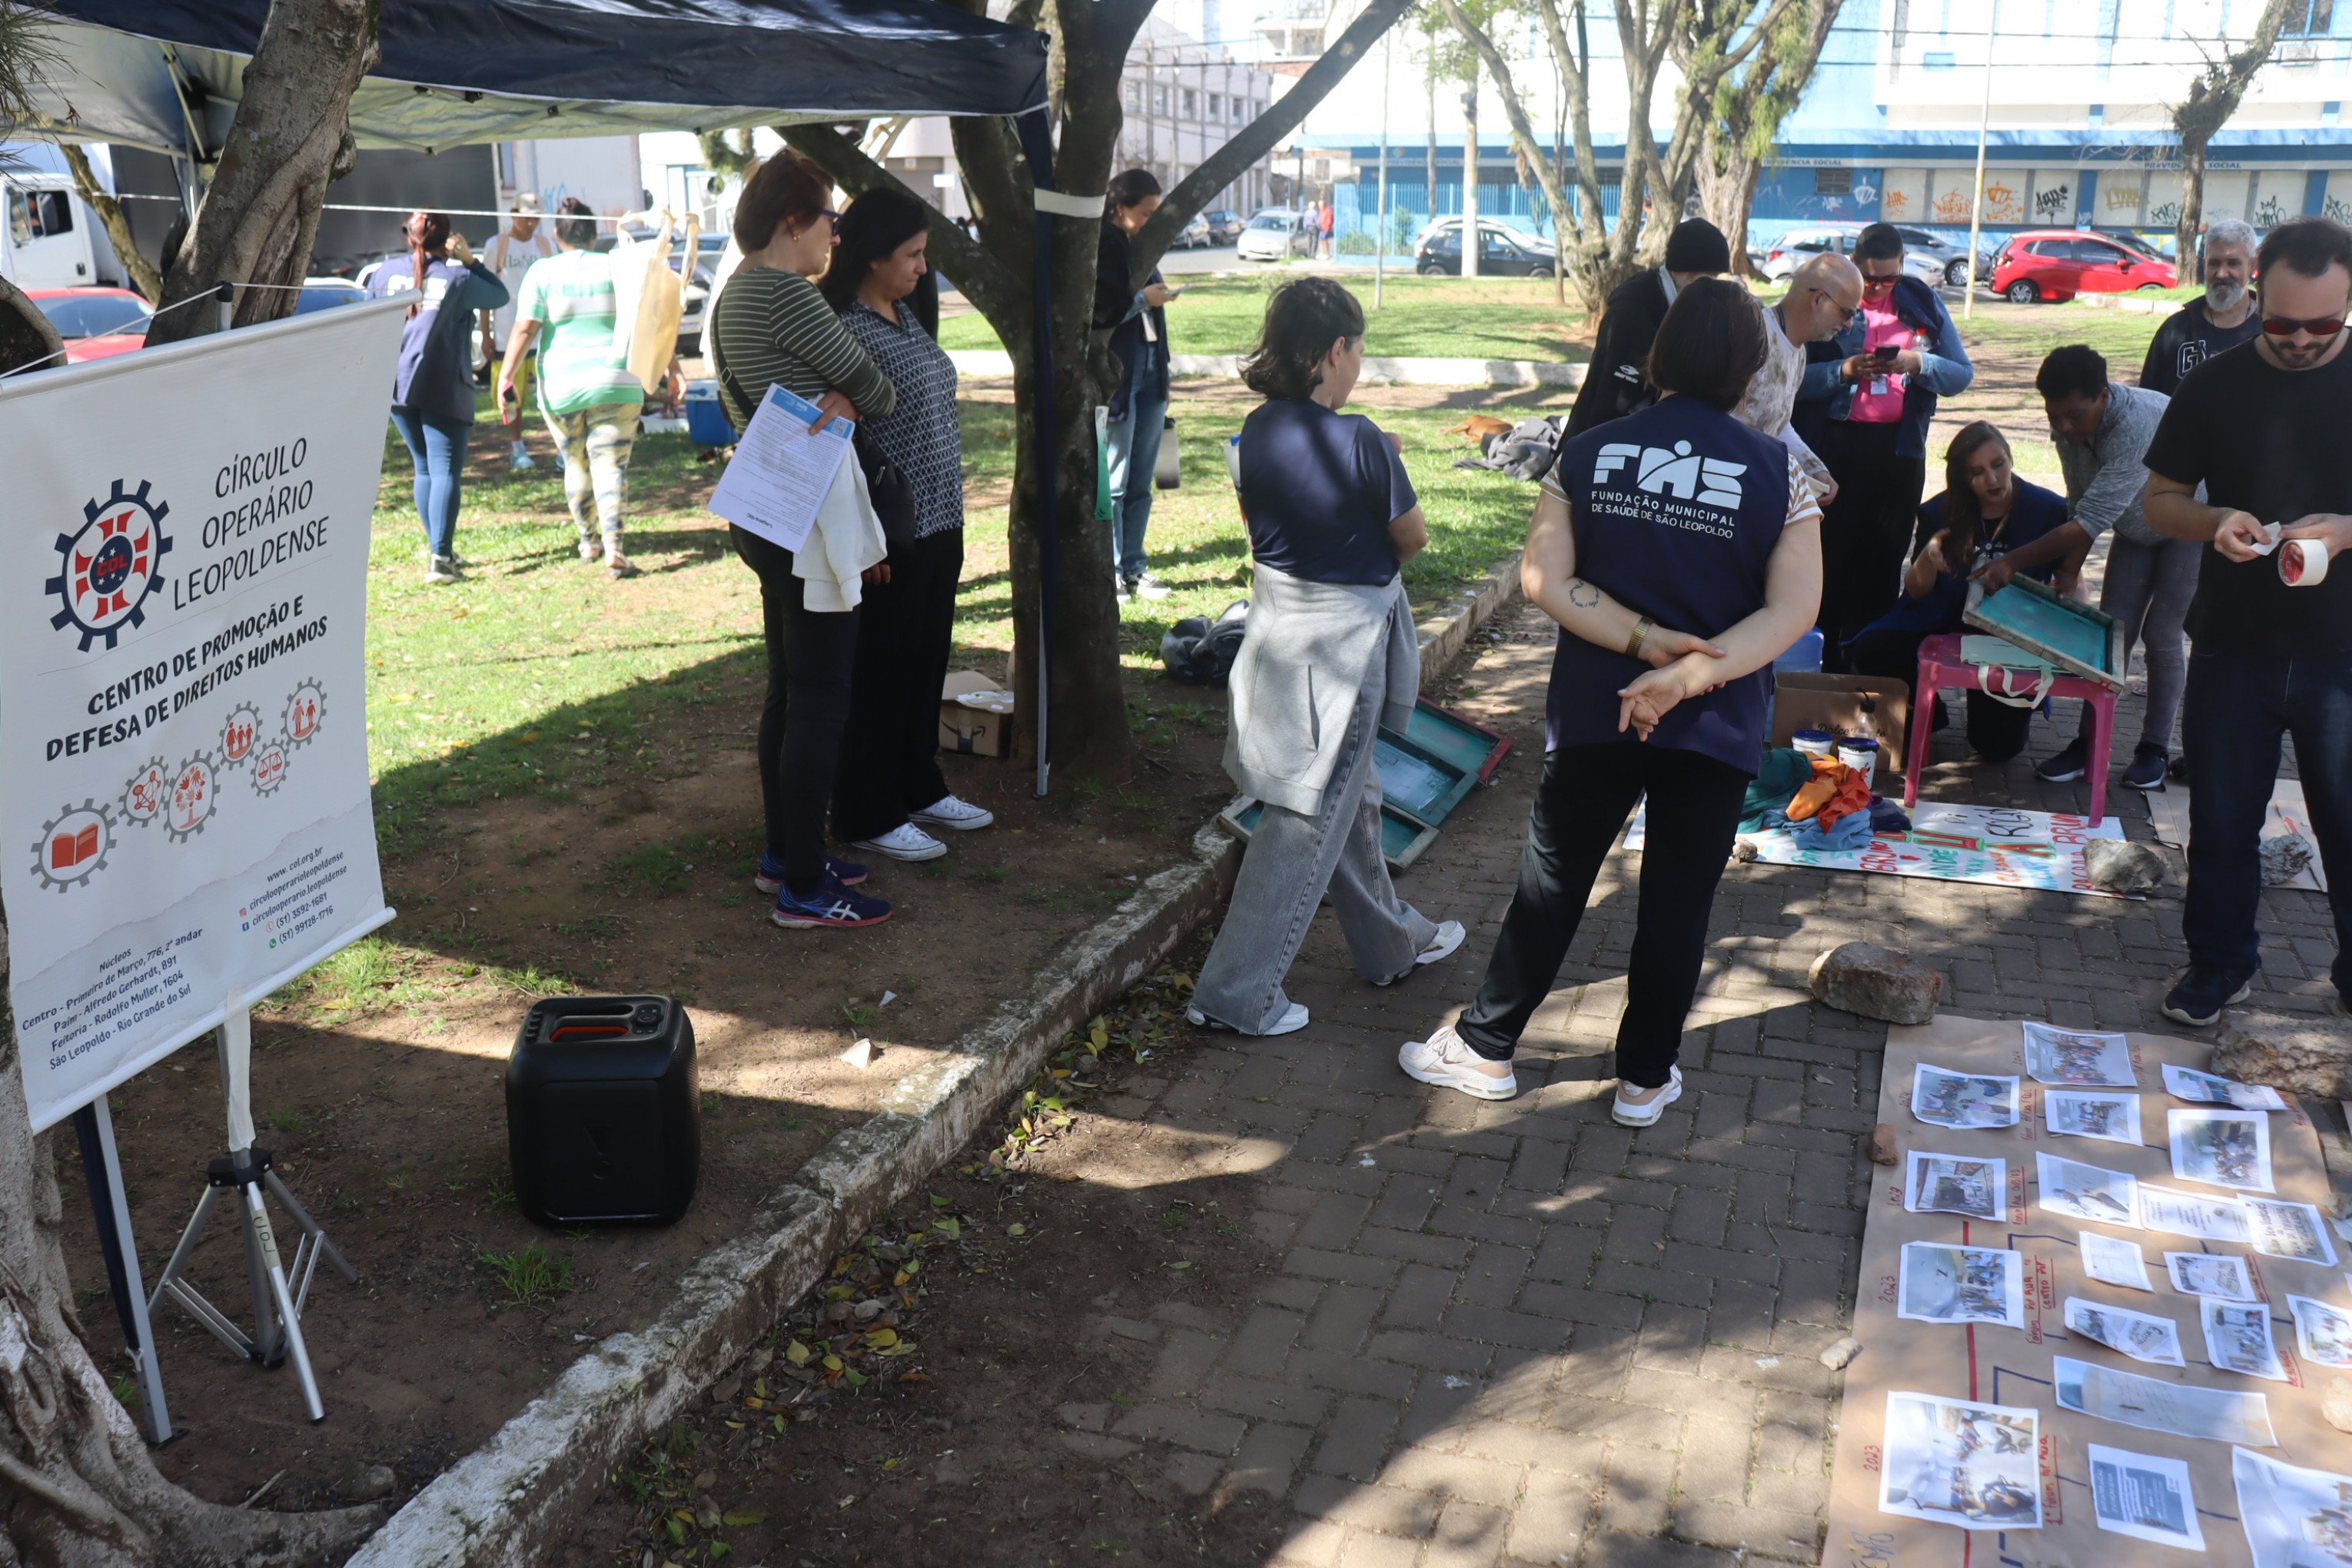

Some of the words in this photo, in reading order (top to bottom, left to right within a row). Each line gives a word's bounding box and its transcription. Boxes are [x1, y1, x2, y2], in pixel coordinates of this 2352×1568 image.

[215, 437, 307, 498] CÍRCULO
[202, 480, 313, 549] OPERÁRIO
[1591, 490, 1659, 510] FUNDAÇÃO
[1665, 503, 1735, 527] MUNICIPAL
[1592, 503, 1603, 513] DE
[1605, 502, 1639, 518] SAÚDE
[1640, 510, 1653, 521] DE
[1656, 513, 1677, 527] SÃO
[1679, 520, 1733, 539] LEOPOLDO
[97, 556, 128, 578] COL
[174, 516, 330, 611] LEOPOLDENSE
[88, 660, 168, 716] CENTRO
[173, 647, 197, 679] DE
[202, 603, 290, 668] PROMOÇÃO
[293, 594, 303, 616] E
[46, 715, 141, 762] DEFESA
[145, 696, 170, 724] DE
[174, 653, 244, 709] DIREITOS
[248, 616, 328, 669] HUMANOS
[250, 852, 344, 910] circulooperarioleopoldense
[1860, 841, 1898, 872] BRUNO
[252, 865, 347, 926] circulooperario.leopoldense
[276, 912, 291, 929] (51)
[291, 892, 327, 919] 3592-1681
[279, 928, 294, 944] (51)
[295, 905, 334, 935] 99128-1716
[22, 1007, 58, 1031] Centro
[67, 982, 104, 1010] Primeiro
[105, 974, 115, 985] de
[117, 958, 146, 978] Março,
[147, 949, 164, 962] 776,
[174, 929, 203, 946] andar
[99, 948, 131, 972] Núcleos
[51, 1025, 87, 1051] Feitoria
[95, 1002, 129, 1025] Rodolfo
[131, 985, 162, 1006] Muller,
[163, 970, 184, 988] 1604
[54, 1016, 78, 1033] Paim
[84, 990, 117, 1016] Alfredo
[118, 968, 161, 993] Gerhardt,
[161, 955, 177, 970] 891
[50, 1056, 67, 1070] São
[68, 1031, 111, 1061] Leopoldo
[118, 1018, 132, 1032] Rio
[134, 1002, 164, 1024] Grande
[167, 994, 178, 1005] do
[179, 983, 191, 998] Sul
[1879, 1275, 1896, 1304] 2023
[1863, 1445, 1881, 1471] 2023
